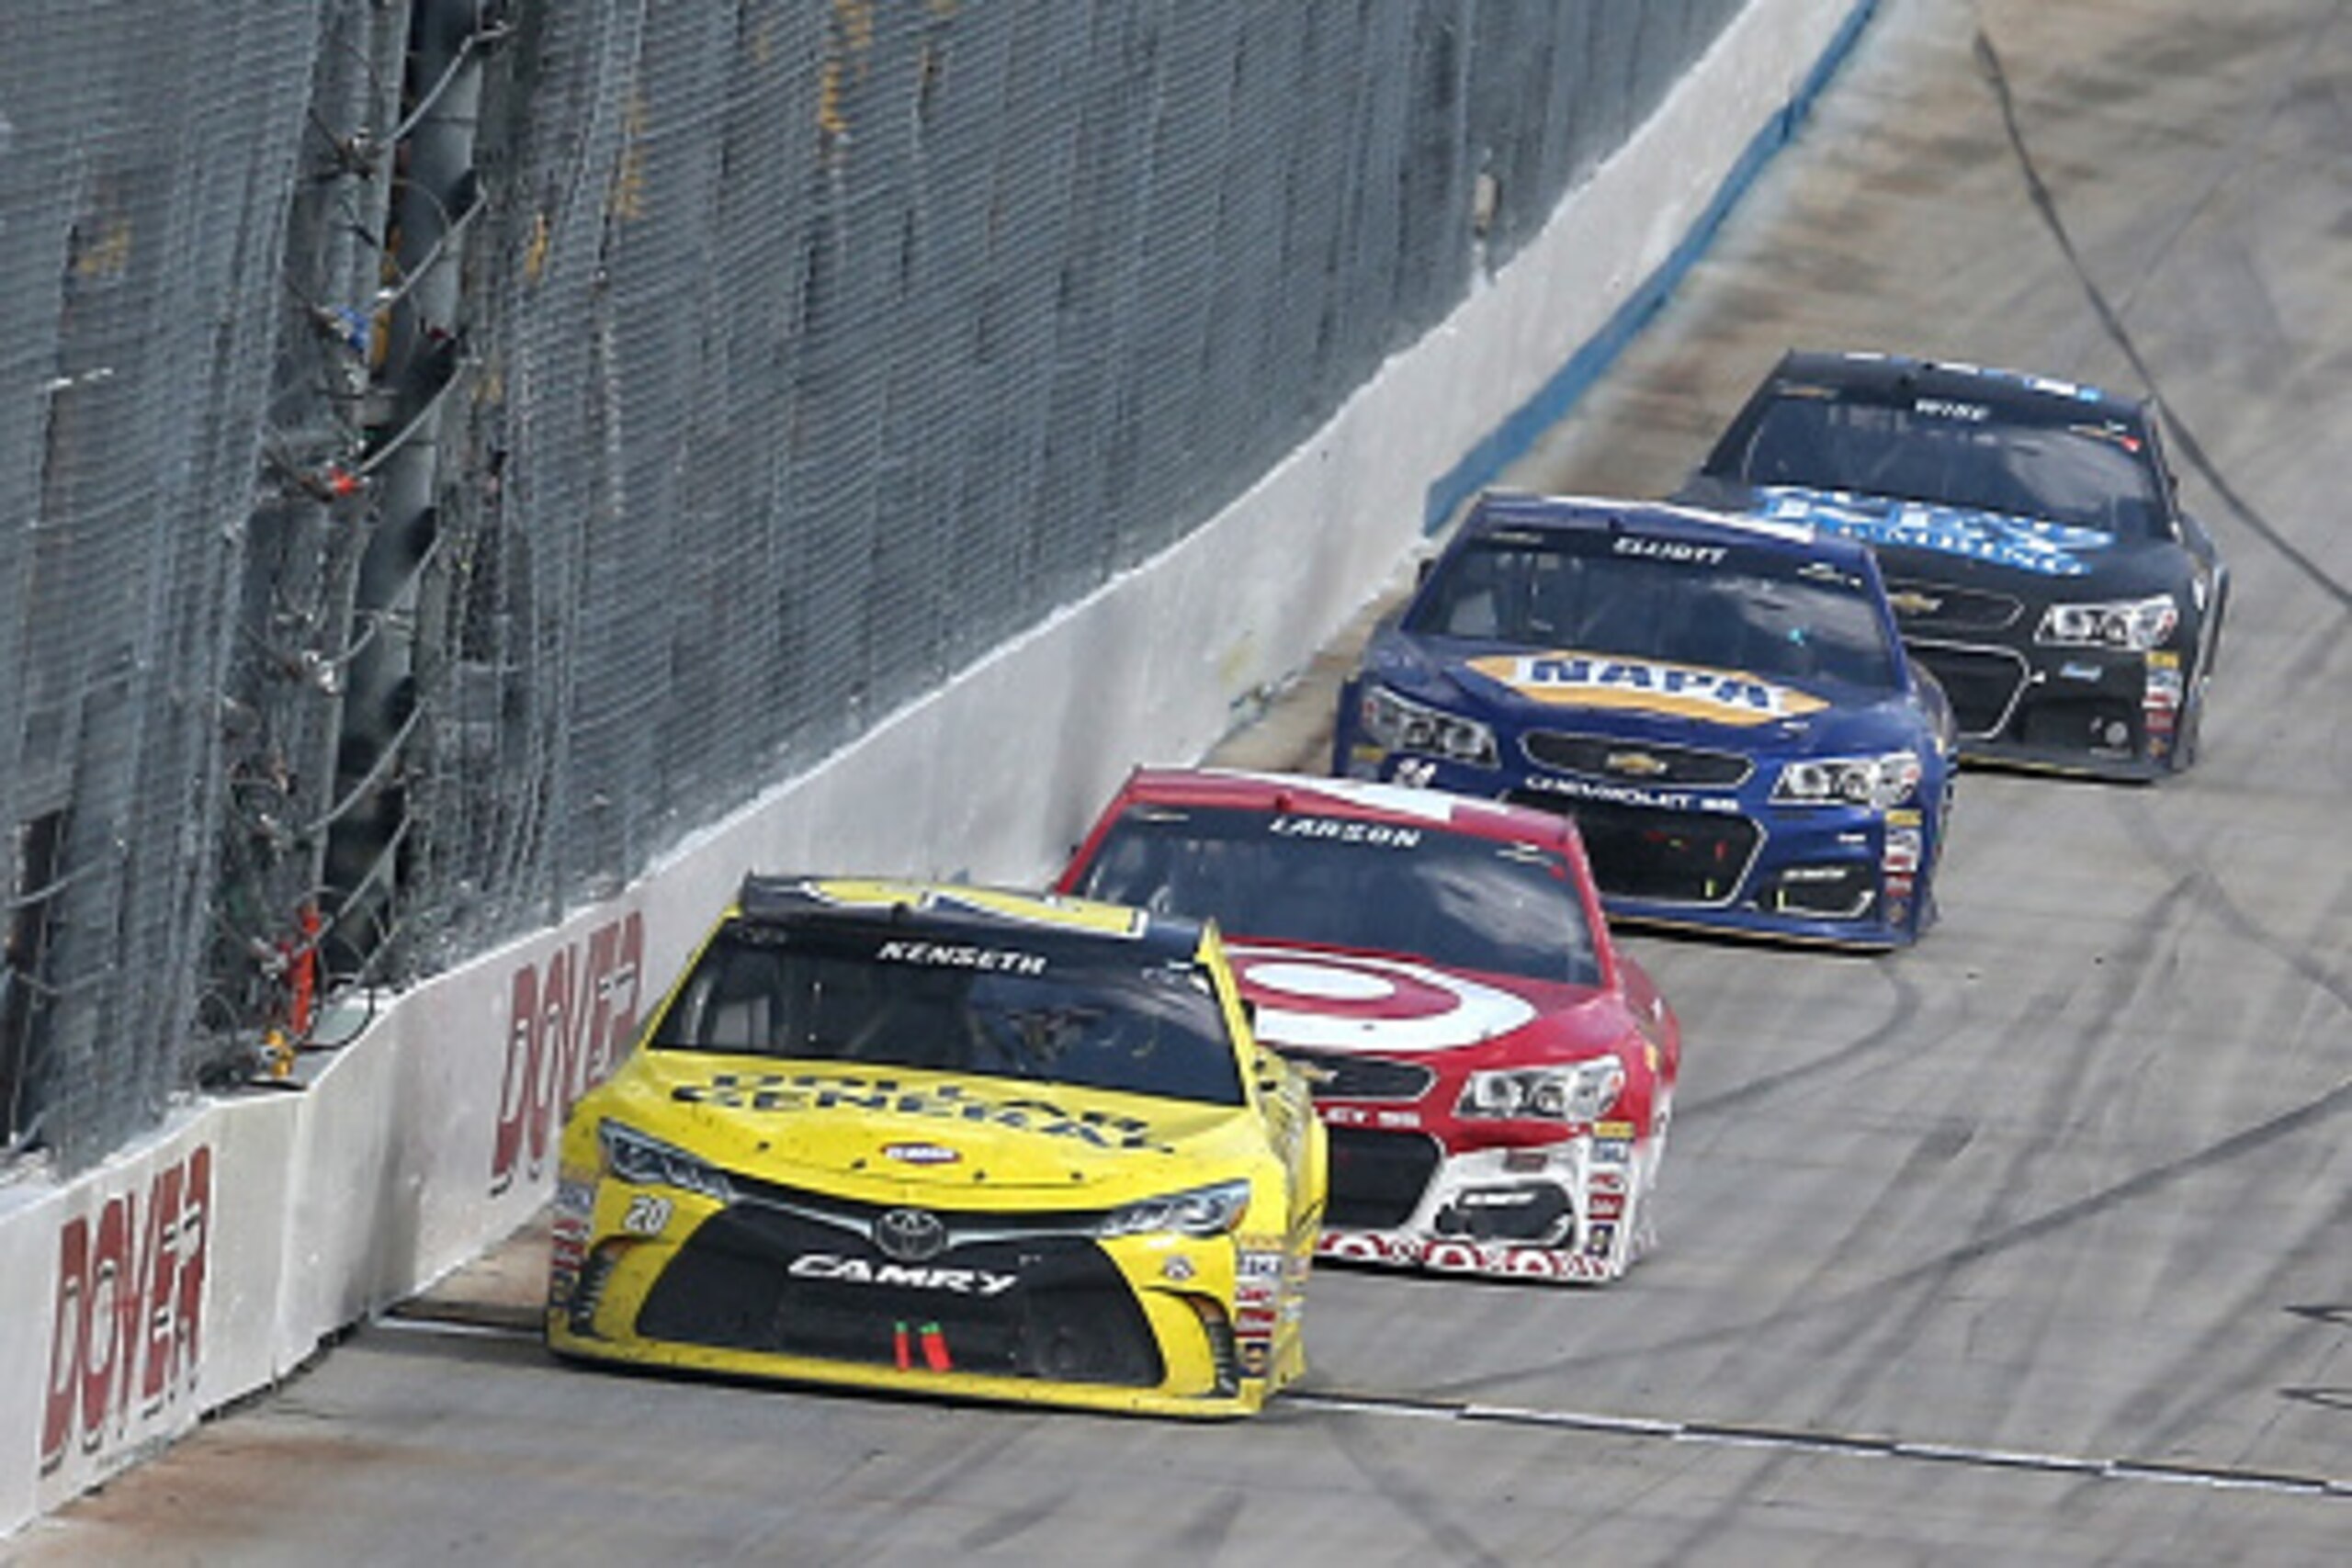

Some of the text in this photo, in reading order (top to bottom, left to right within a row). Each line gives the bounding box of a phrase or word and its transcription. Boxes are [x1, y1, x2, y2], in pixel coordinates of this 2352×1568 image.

[1612, 536, 1727, 565] ELLIOTT
[1531, 659, 1770, 709] NAPA
[1525, 775, 1693, 810] CHEVROLET
[1269, 814, 1422, 849] LARSON
[875, 941, 1048, 976] KENSETH
[624, 1194, 675, 1236] 20
[788, 1252, 1019, 1296] CAMRY
[40, 1145, 211, 1475] DOVER
